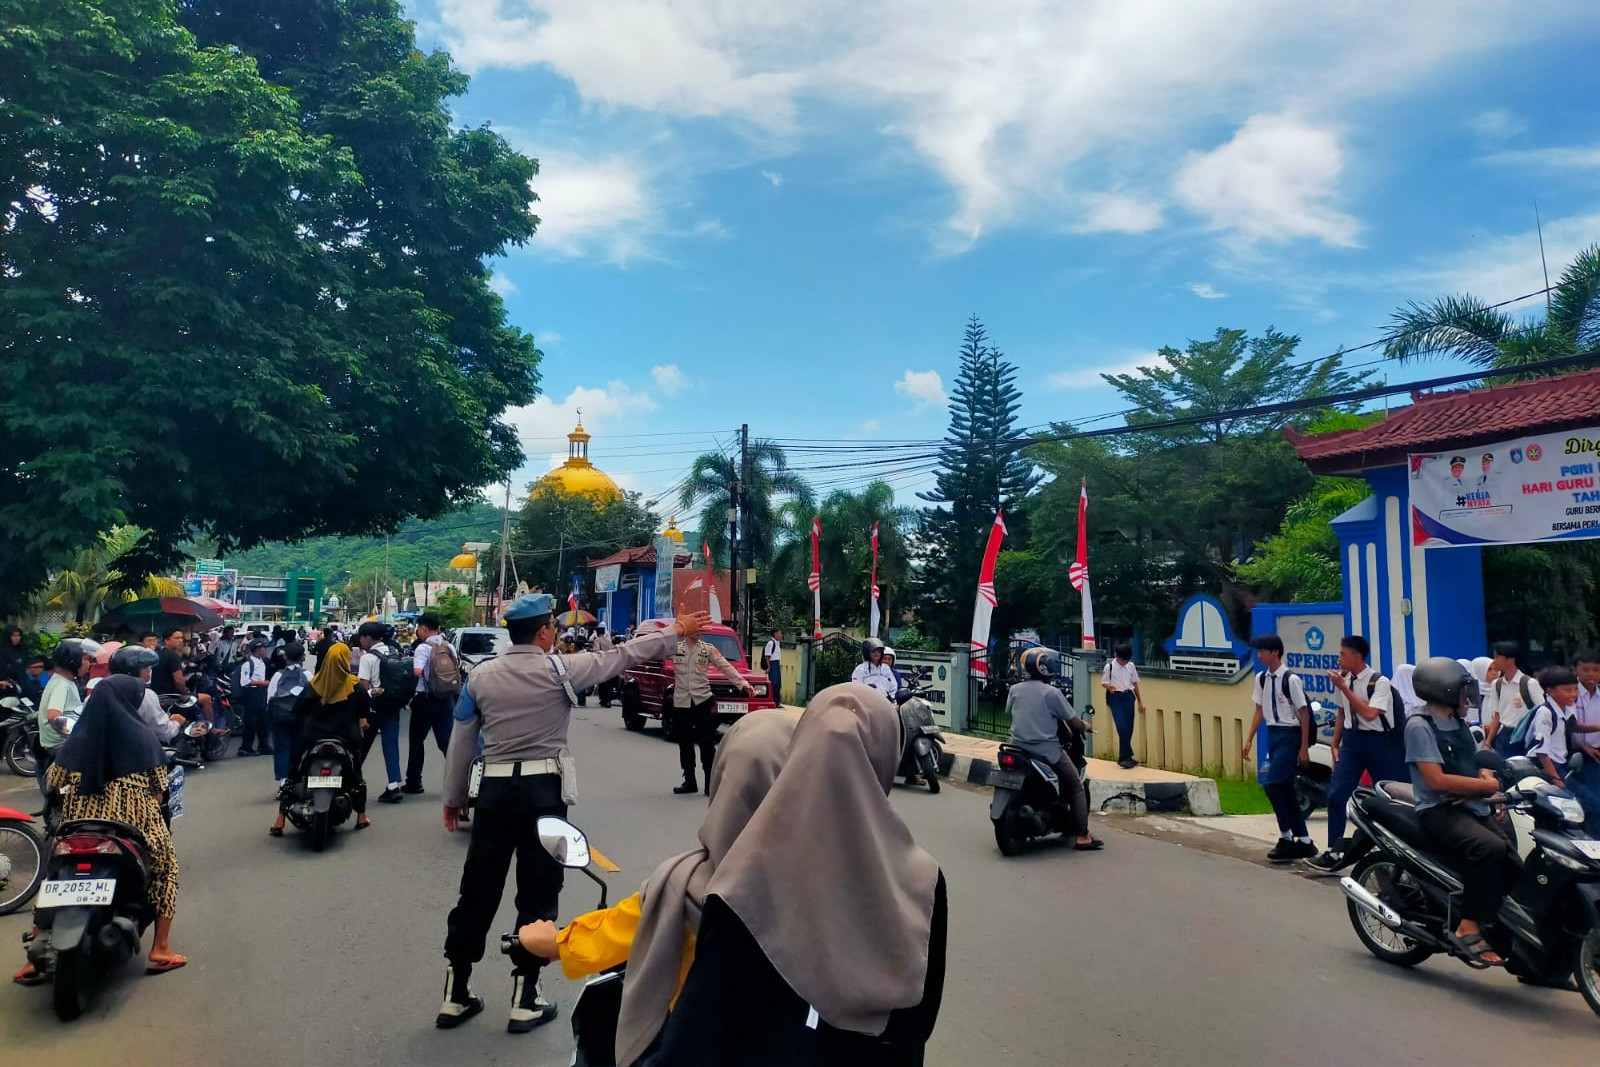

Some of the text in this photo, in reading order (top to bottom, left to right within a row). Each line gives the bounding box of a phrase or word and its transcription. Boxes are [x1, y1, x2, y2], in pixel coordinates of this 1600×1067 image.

[1561, 463, 1593, 477] PGRI
[1522, 481, 1553, 495] HARI
[1556, 478, 1594, 491] GURU
[1565, 506, 1584, 516] GURU
[1552, 520, 1581, 532] BERSAMA
[62, 882, 92, 893] 2052
[96, 882, 110, 892] ML
